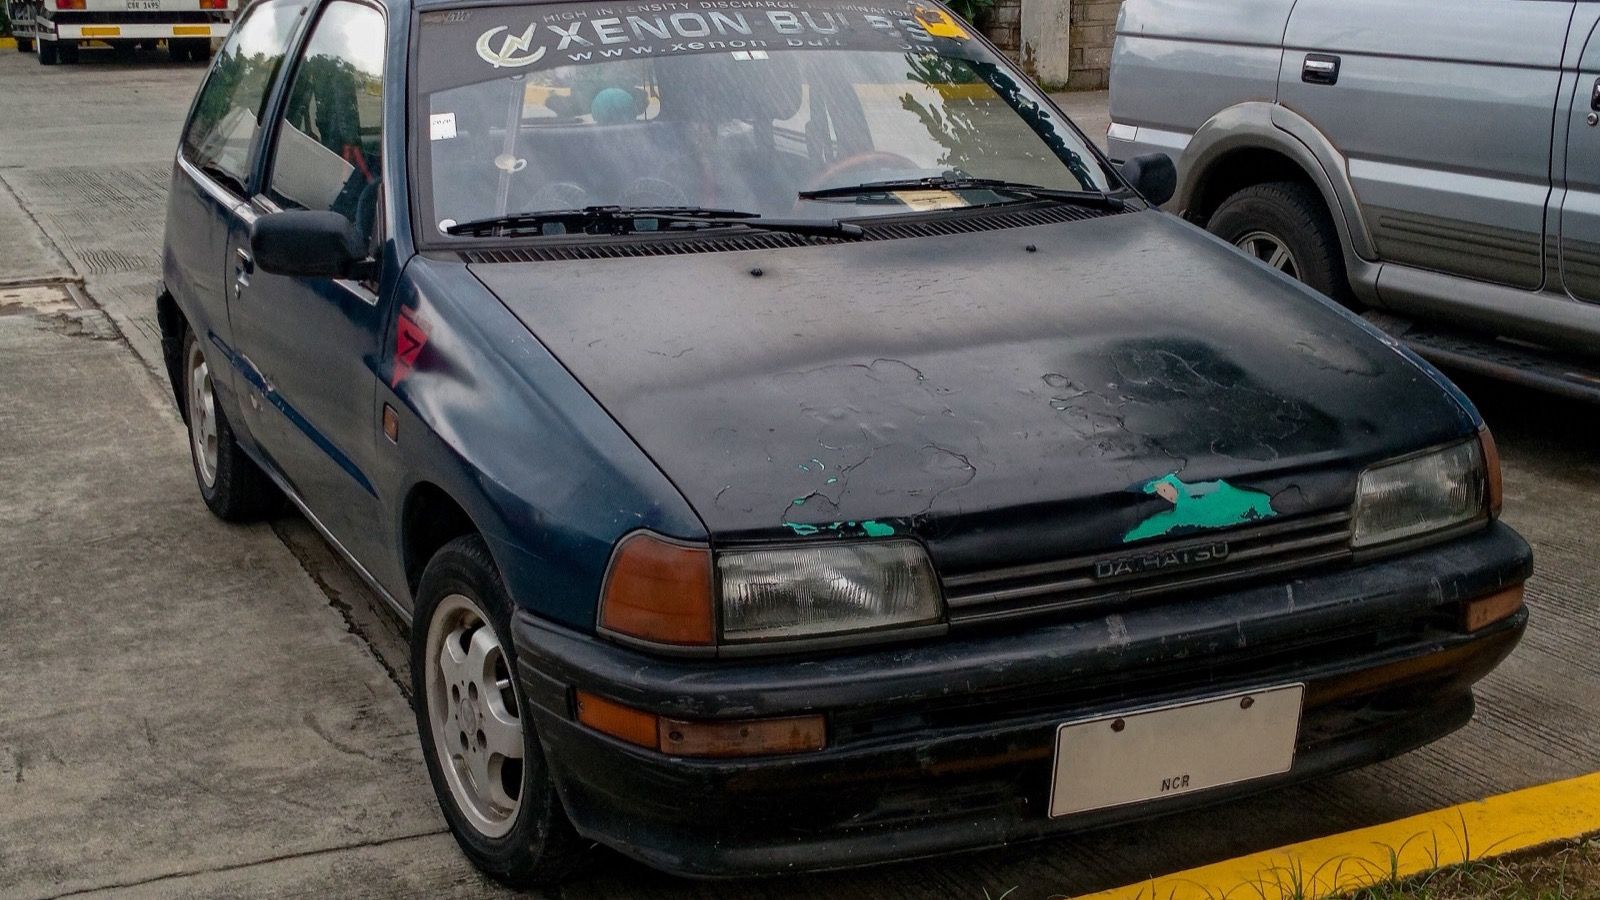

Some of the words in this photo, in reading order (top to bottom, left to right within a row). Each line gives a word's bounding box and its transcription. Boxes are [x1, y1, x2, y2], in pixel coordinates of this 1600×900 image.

[542, 10, 588, 23] HIGH
[699, 1, 800, 9] DISCHARGE
[547, 11, 753, 50] XENON
[1097, 540, 1229, 578] DAHATSU
[1161, 775, 1190, 792] NCR
